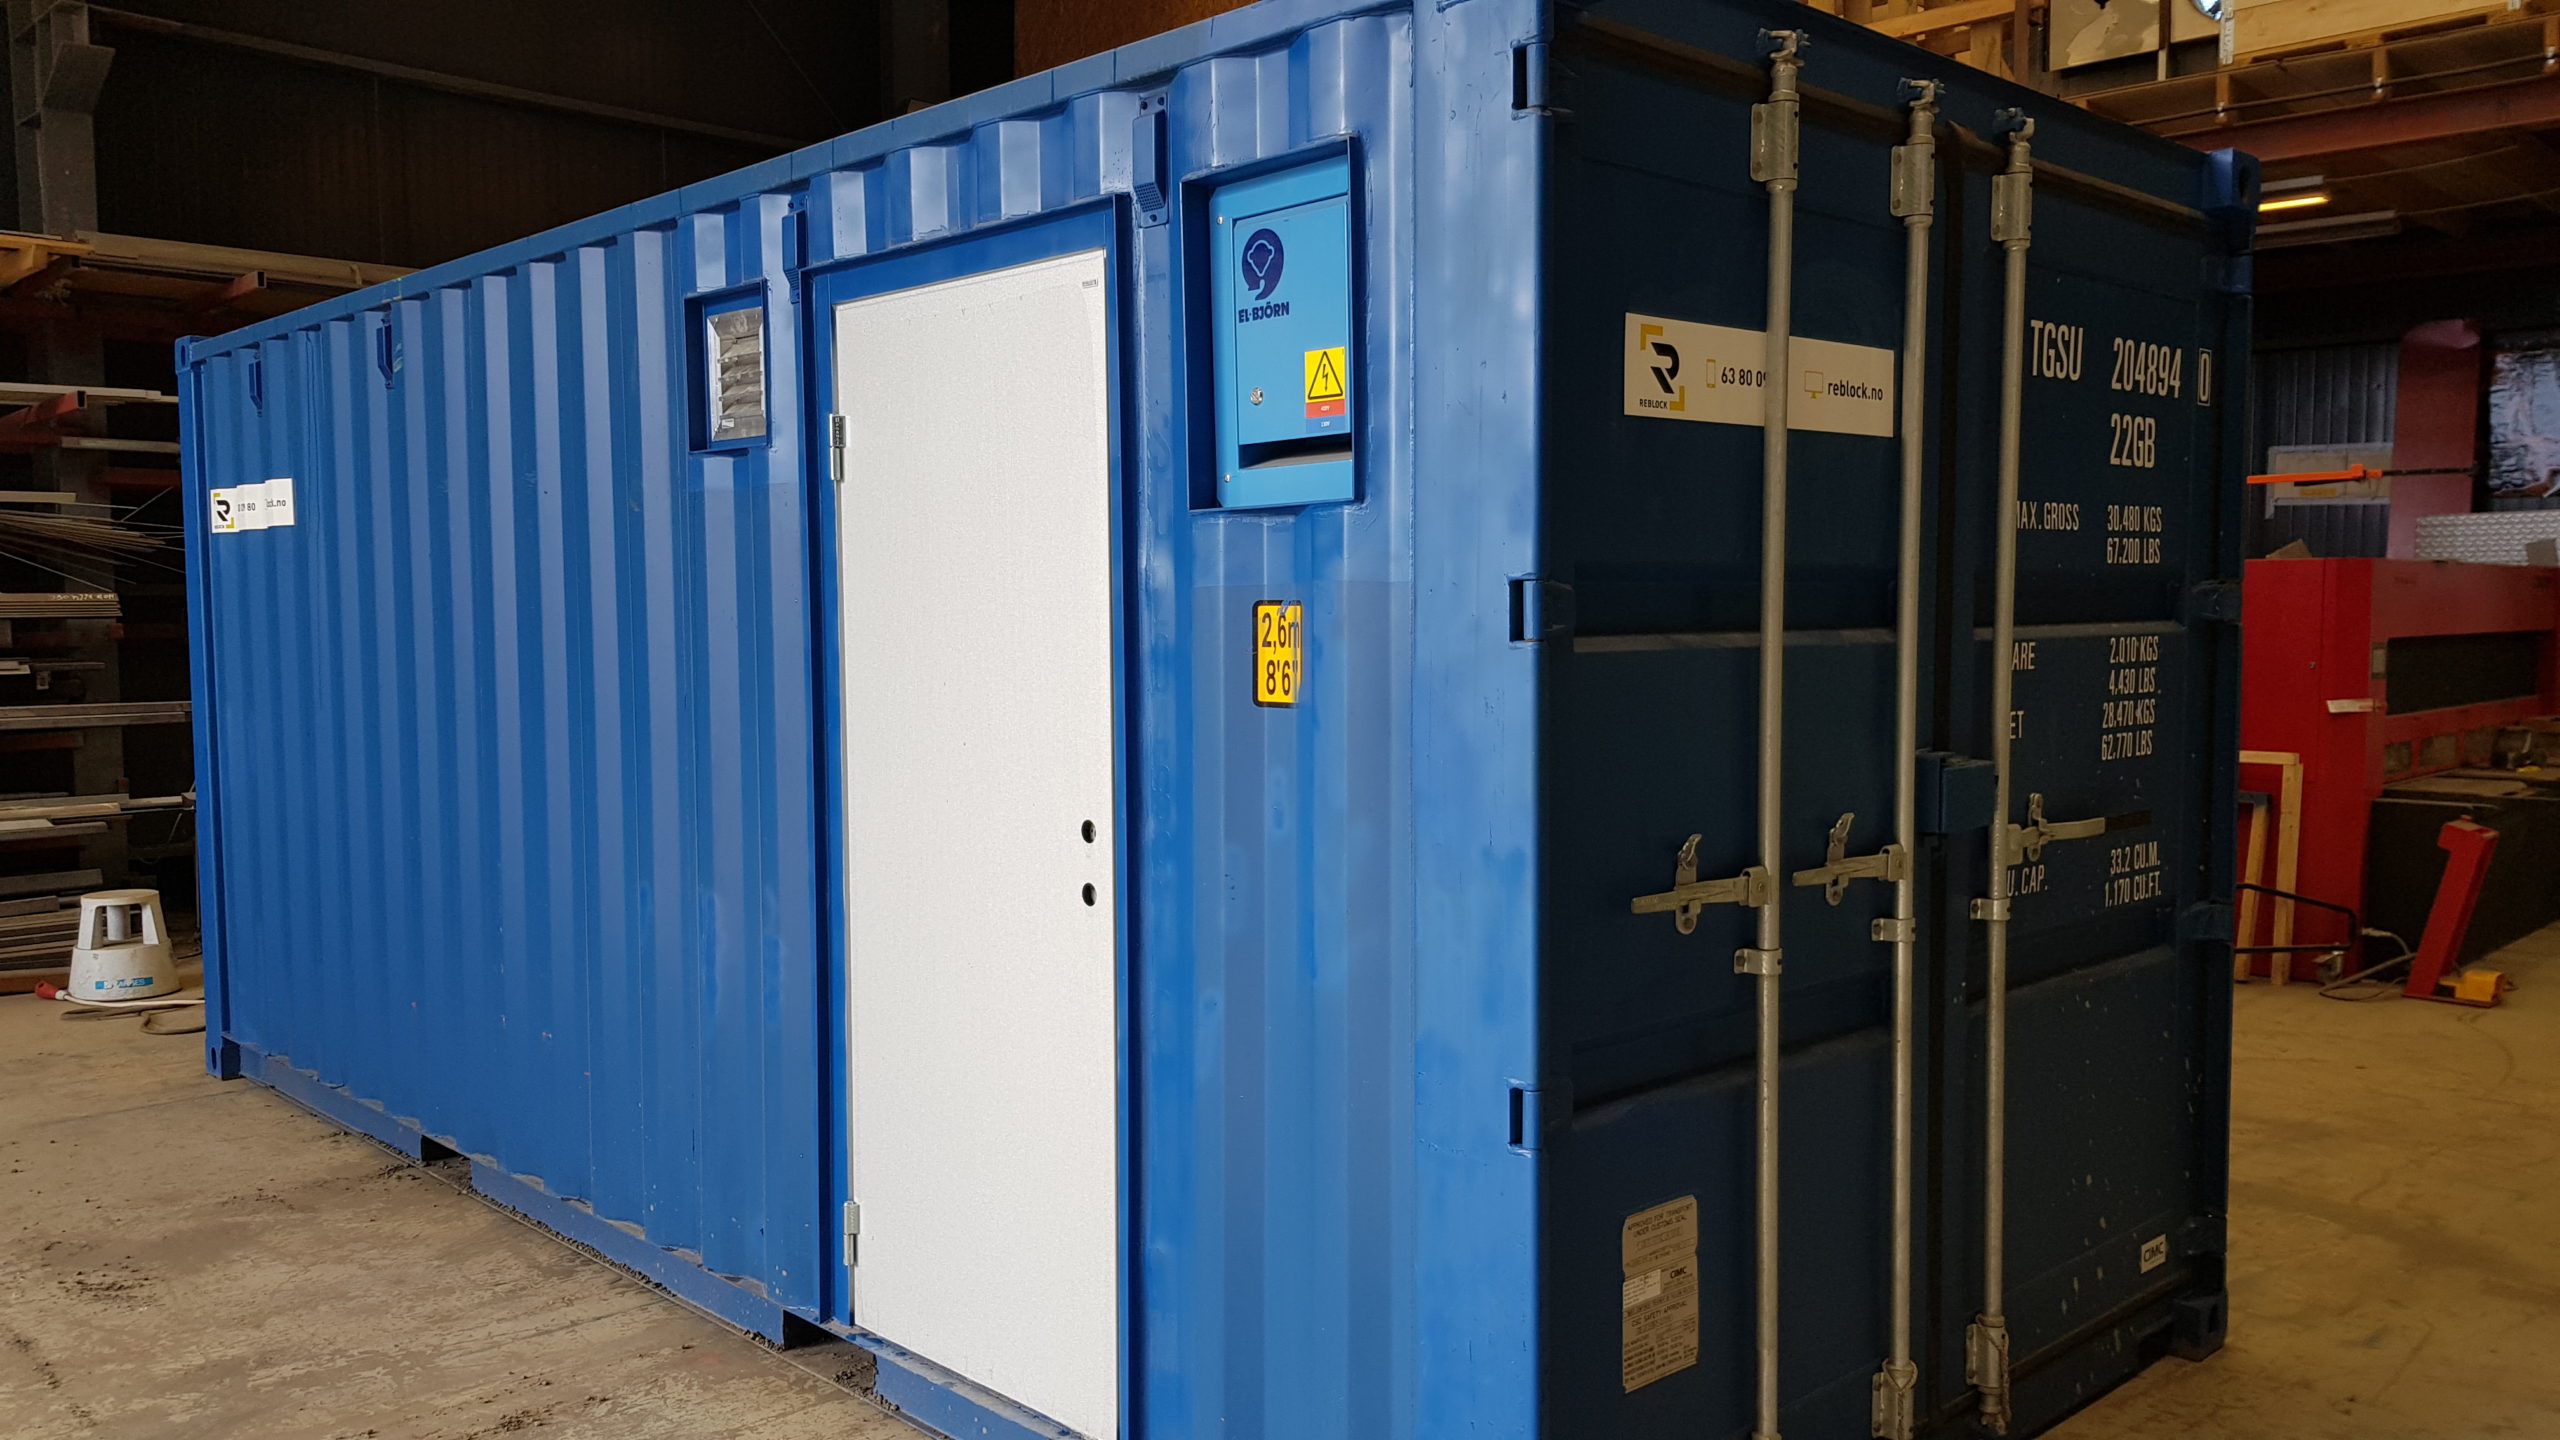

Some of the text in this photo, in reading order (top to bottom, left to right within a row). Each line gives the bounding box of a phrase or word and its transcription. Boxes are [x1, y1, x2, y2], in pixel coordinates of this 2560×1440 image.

[2030, 319, 2084, 381] TGSU
[2111, 336, 2182, 399] 204894
[1721, 366, 1735, 384] 63
[1739, 367, 1753, 386] 80
[1827, 379, 1884, 401] reblock.no
[1639, 398, 1668, 410] REBLOCK
[2110, 412, 2156, 468] 22GB
[2143, 506, 2162, 533] KGS
[2143, 538, 2161, 564] LBS
[2011, 641, 2037, 671] ARE
[2140, 635, 2159, 662] KGS
[2138, 667, 2156, 693] LBS
[2009, 710, 2025, 740] ET
[2136, 698, 2156, 724] KGS
[2135, 729, 2153, 756] LBS
[2006, 869, 2019, 897] U.
[2110, 846, 2131, 875] 33.2
[1669, 1266, 1687, 1279] CIMC
